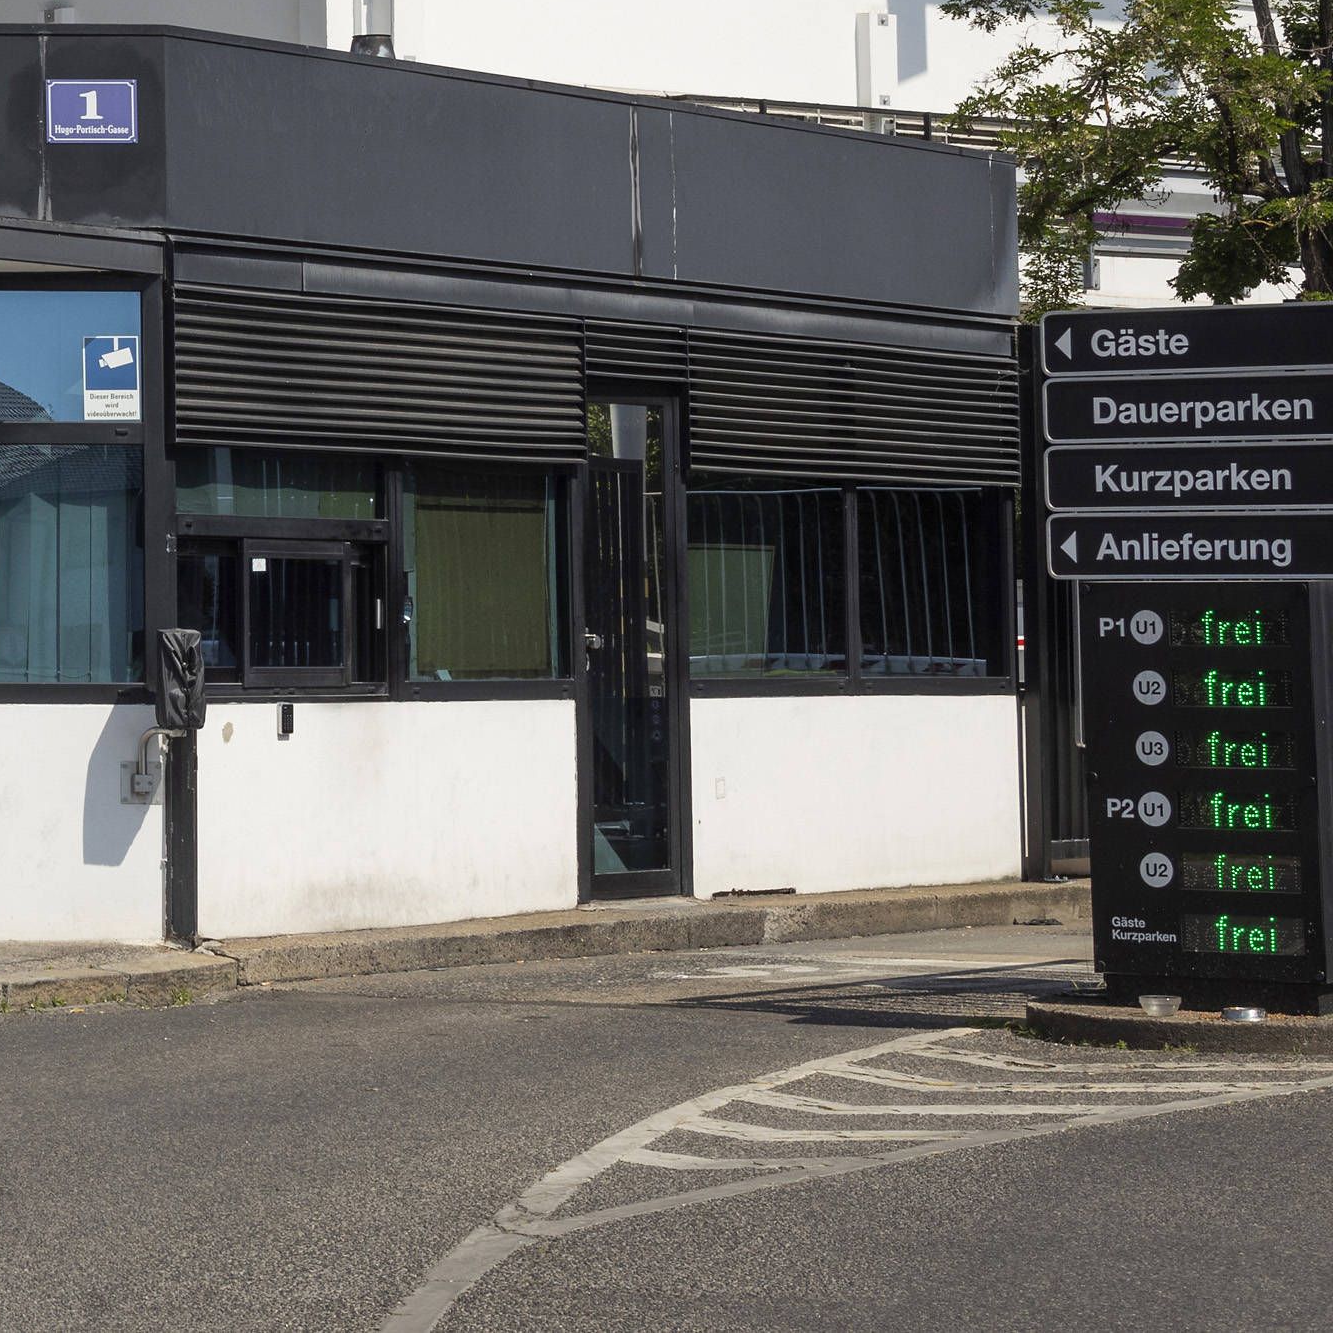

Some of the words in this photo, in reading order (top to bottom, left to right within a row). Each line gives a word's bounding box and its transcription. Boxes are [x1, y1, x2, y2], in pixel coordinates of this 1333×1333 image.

[79, 90, 103, 119] 1
[54, 124, 129, 135] Hugo-Portisch-Gasse
[1090, 328, 1190, 358] Gäste
[1092, 392, 1314, 429] Dauerparken
[1094, 462, 1292, 498] Kurzparken
[1095, 532, 1292, 567] Anlieferung
[1099, 617, 1126, 637] P1
[1135, 620, 1156, 635] U1
[1201, 609, 1262, 645] frei
[1138, 680, 1162, 696] U2
[1203, 670, 1266, 706] frei
[1141, 740, 1165, 756] U3
[1207, 731, 1268, 767] frei
[1106, 798, 1134, 819] P2
[1143, 801, 1165, 817] U1
[1211, 792, 1272, 829] frei
[1145, 862, 1169, 878] U2
[1215, 853, 1275, 890] frei
[1111, 916, 1146, 929] Gäste
[1111, 928, 1177, 944] Kurzparken
[1215, 915, 1277, 953] frei
